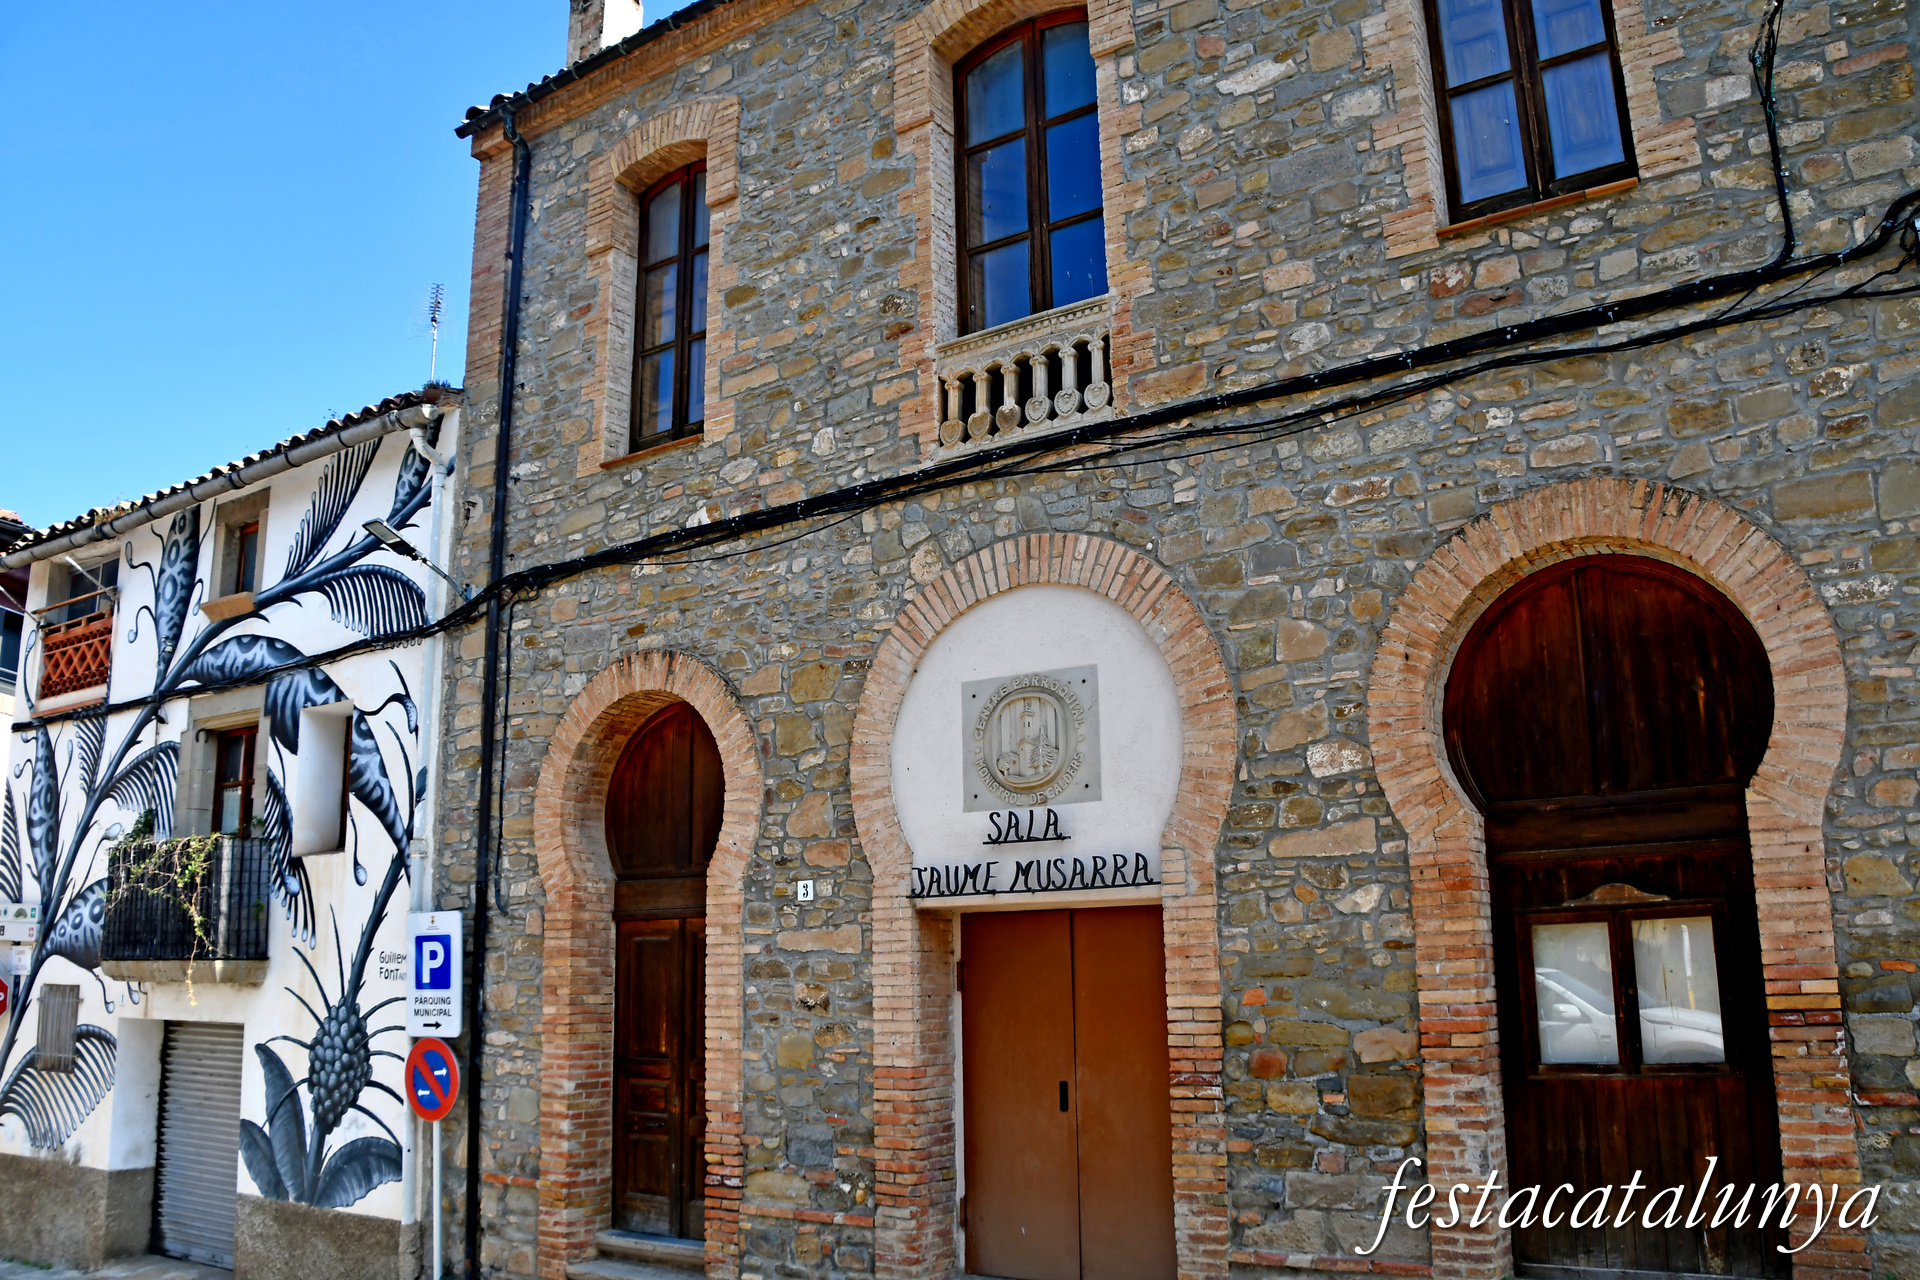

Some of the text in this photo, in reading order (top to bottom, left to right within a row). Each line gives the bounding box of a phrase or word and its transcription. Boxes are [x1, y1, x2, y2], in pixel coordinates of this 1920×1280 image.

[975, 675, 1085, 741] CENTRE PARROQUIAL
[976, 751, 1084, 806] MONISTROL DE CALDERS
[988, 808, 1063, 844] SALA
[802, 883, 809, 898] 3
[911, 852, 1153, 897] JAUME MUSARRA
[422, 941, 445, 984] P
[413, 1008, 452, 1017] MUNICIPAL
[414, 995, 451, 1005] PÀRQUING
